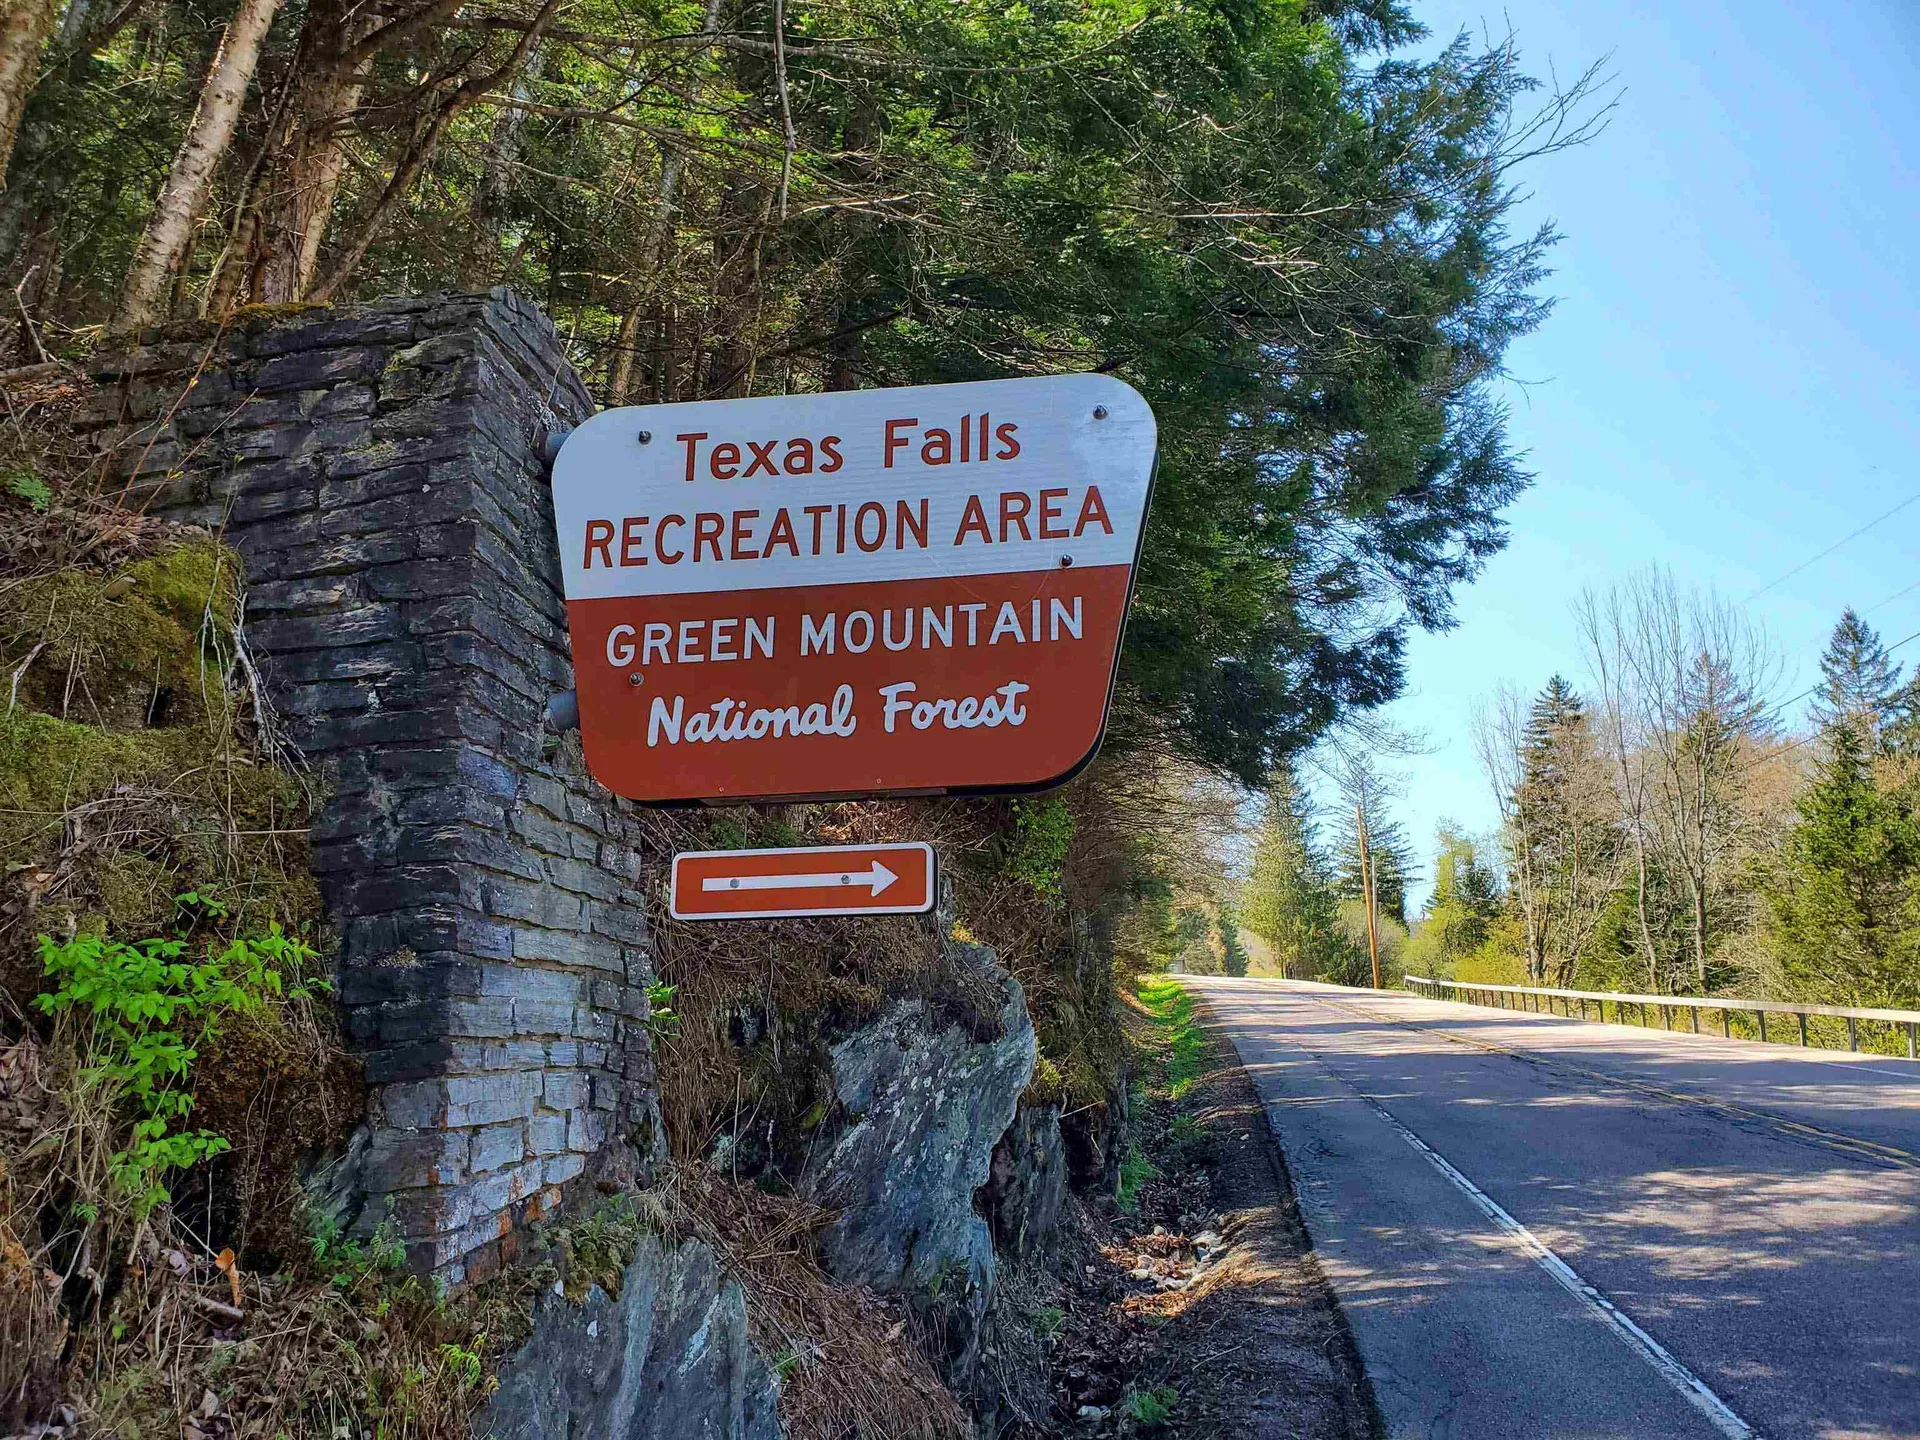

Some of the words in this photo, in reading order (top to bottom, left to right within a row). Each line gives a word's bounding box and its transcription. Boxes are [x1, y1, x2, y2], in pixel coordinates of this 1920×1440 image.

[676, 432, 843, 481] Texas
[883, 412, 1021, 469] Falls
[583, 498, 929, 570] RECREATION
[953, 485, 1115, 546] AREA
[605, 616, 775, 667] GREEN
[800, 596, 1083, 657] MOUNTAIN
[647, 684, 856, 748] National
[878, 681, 1030, 734] Forest
